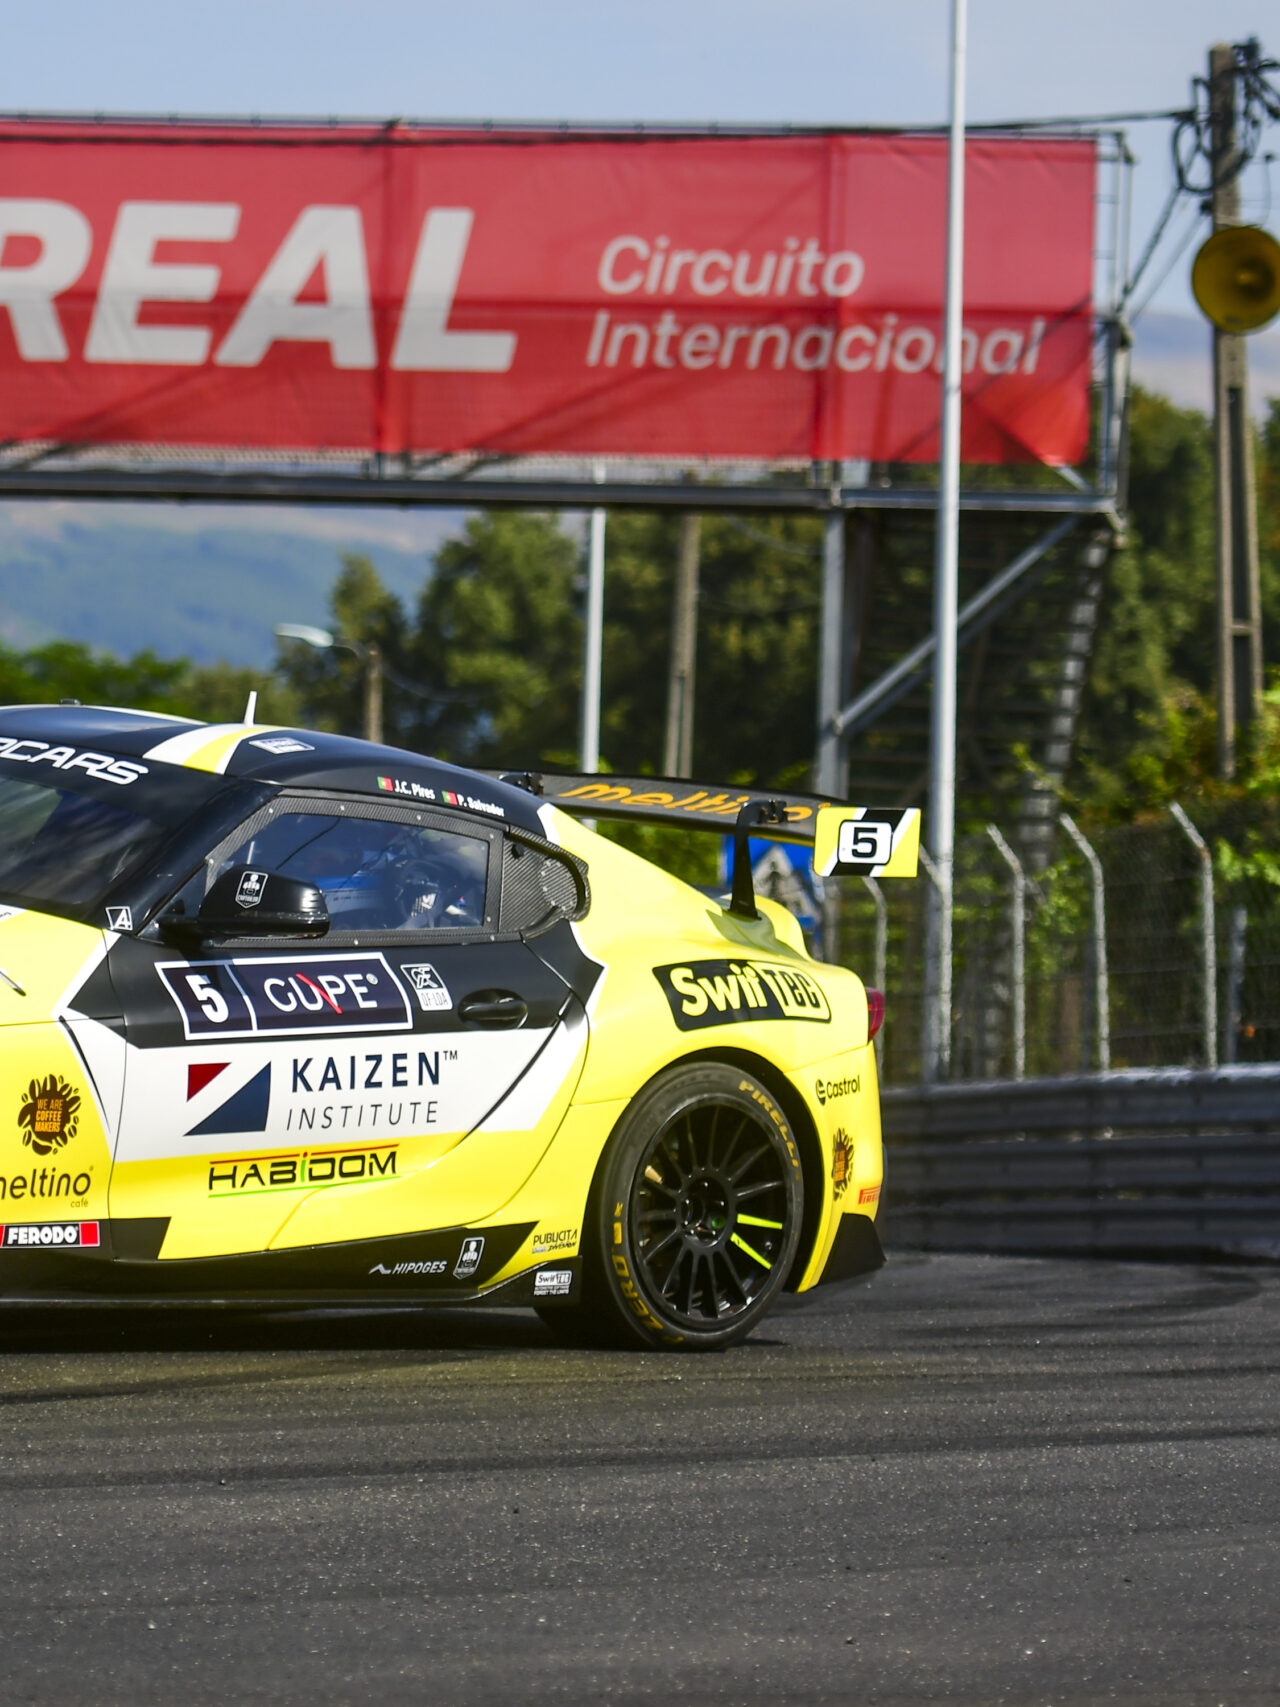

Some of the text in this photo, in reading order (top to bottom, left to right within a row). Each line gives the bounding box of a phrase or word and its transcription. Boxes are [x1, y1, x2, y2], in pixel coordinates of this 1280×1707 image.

[598, 235, 864, 297] Circuito
[586, 310, 1046, 375] Internacional
[394, 780, 436, 800] J.C. Pires
[851, 827, 878, 859] 5
[185, 975, 229, 1023] 5
[826, 1074, 861, 1099] Castrol
[37, 1099, 64, 1110] WE ARE
[35, 1110, 62, 1122] COFFEE
[286, 1101, 439, 1131] INSTITUTE
[34, 1121, 61, 1132] MAKERS
[70, 1197, 89, 1208] café
[7, 1225, 78, 1245] FERODO
[392, 1261, 448, 1275] HIPOGES
